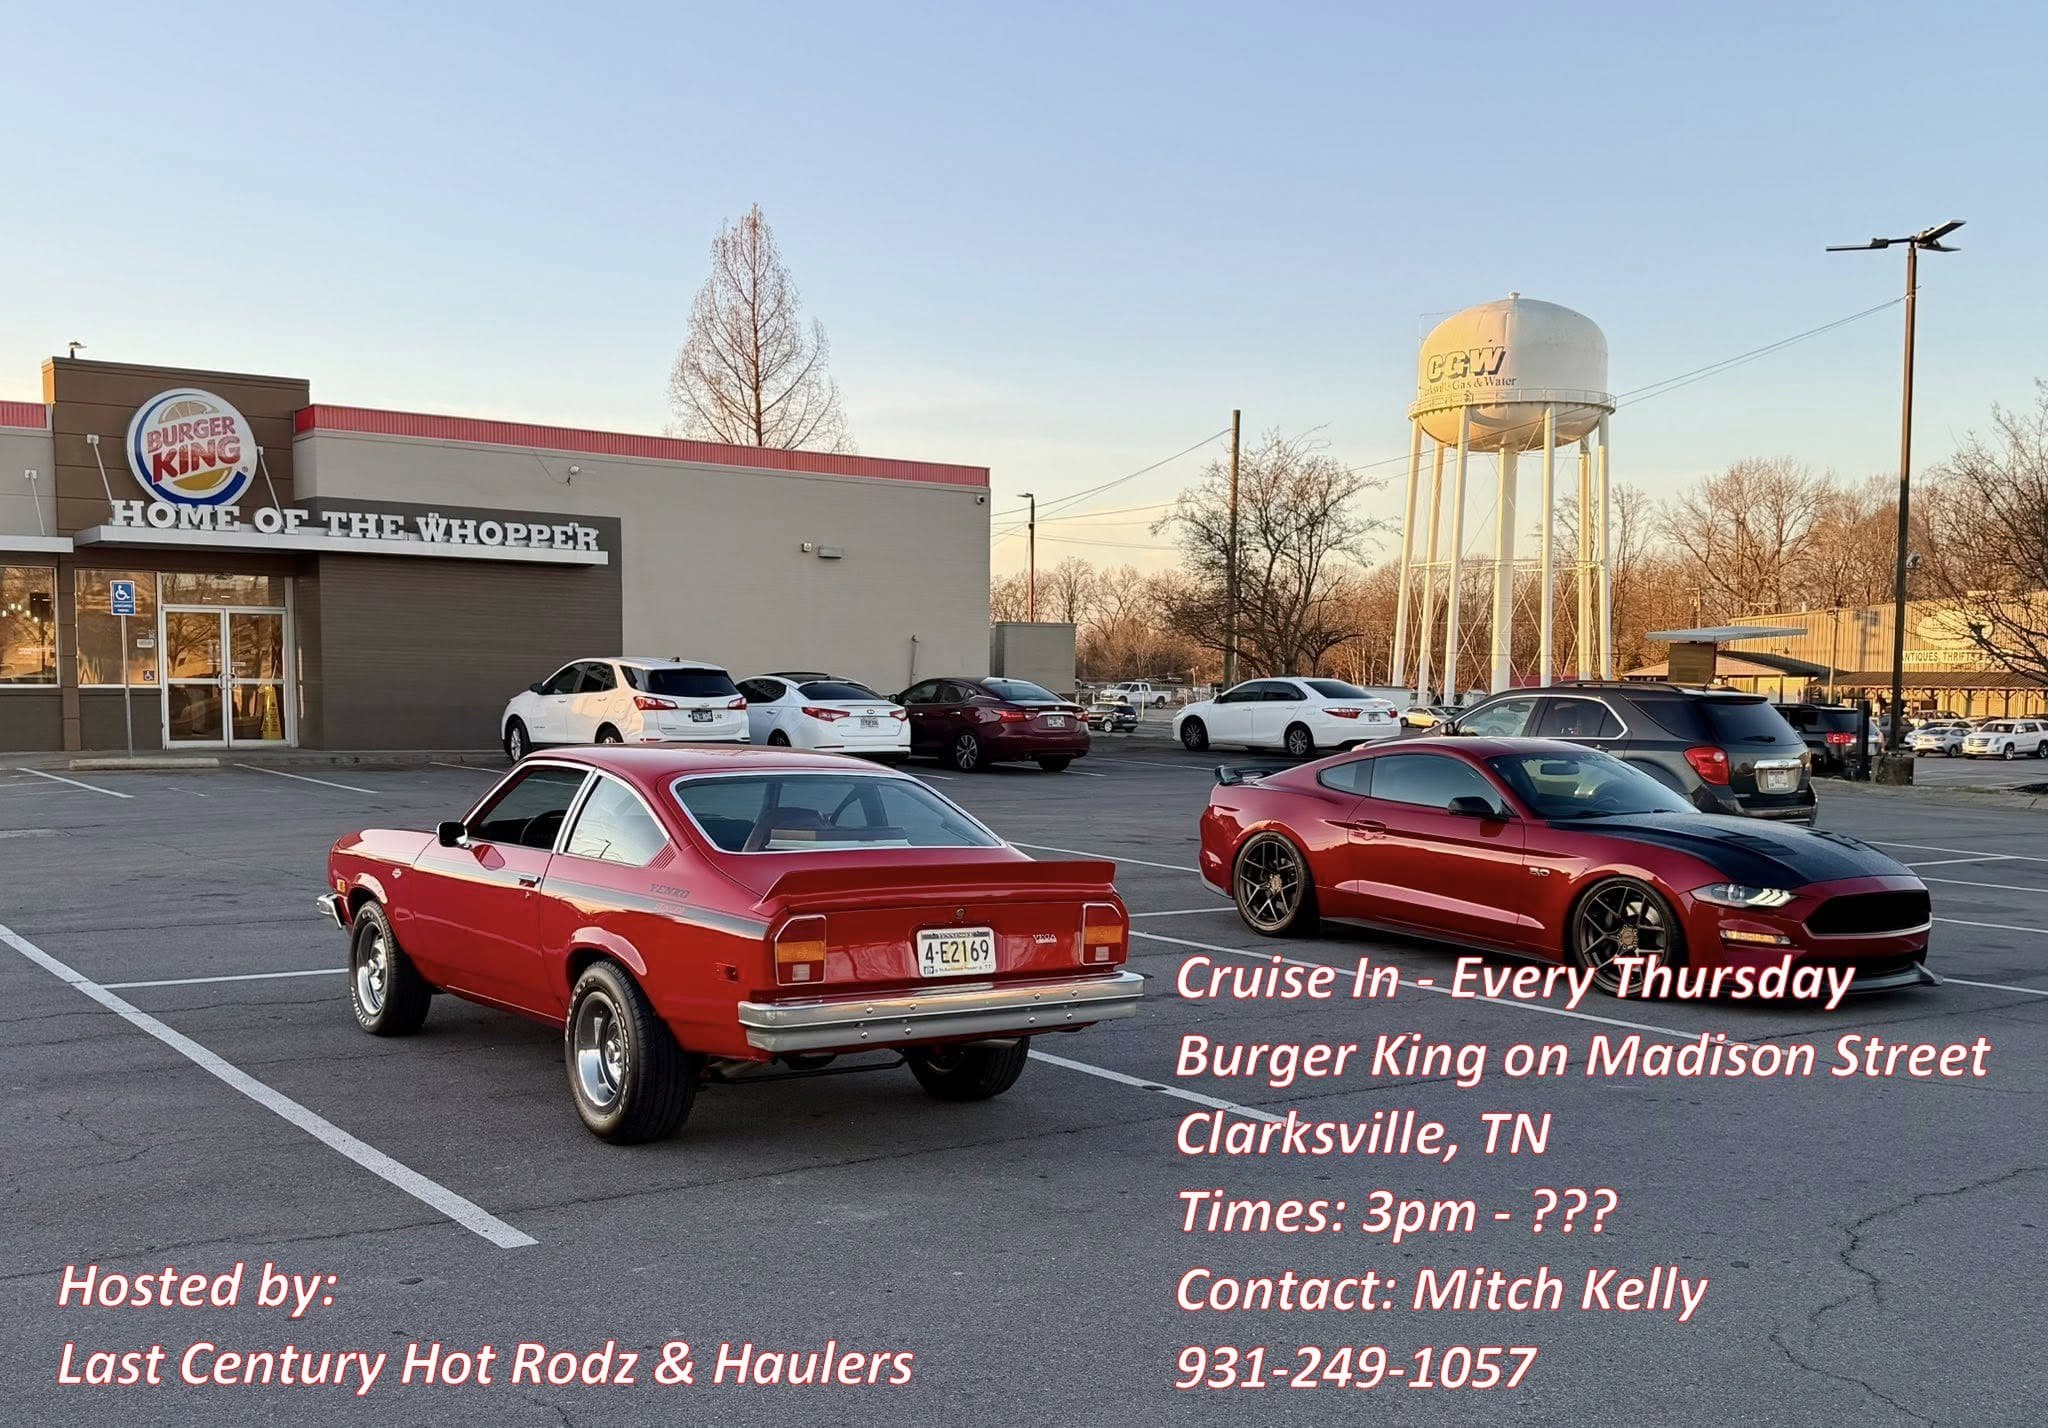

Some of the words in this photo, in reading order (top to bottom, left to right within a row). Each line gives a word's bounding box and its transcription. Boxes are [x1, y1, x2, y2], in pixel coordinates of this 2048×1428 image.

[1427, 346, 1506, 383] CGW
[1452, 380, 1472, 390] Gas
[1474, 378, 1482, 387] &
[1482, 376, 1517, 387] Water
[146, 416, 236, 454] BURGER
[152, 435, 241, 483] KING
[112, 500, 241, 531] HOME
[254, 506, 309, 534] OF
[322, 511, 404, 540] THE
[925, 939, 989, 964] 4-E2169
